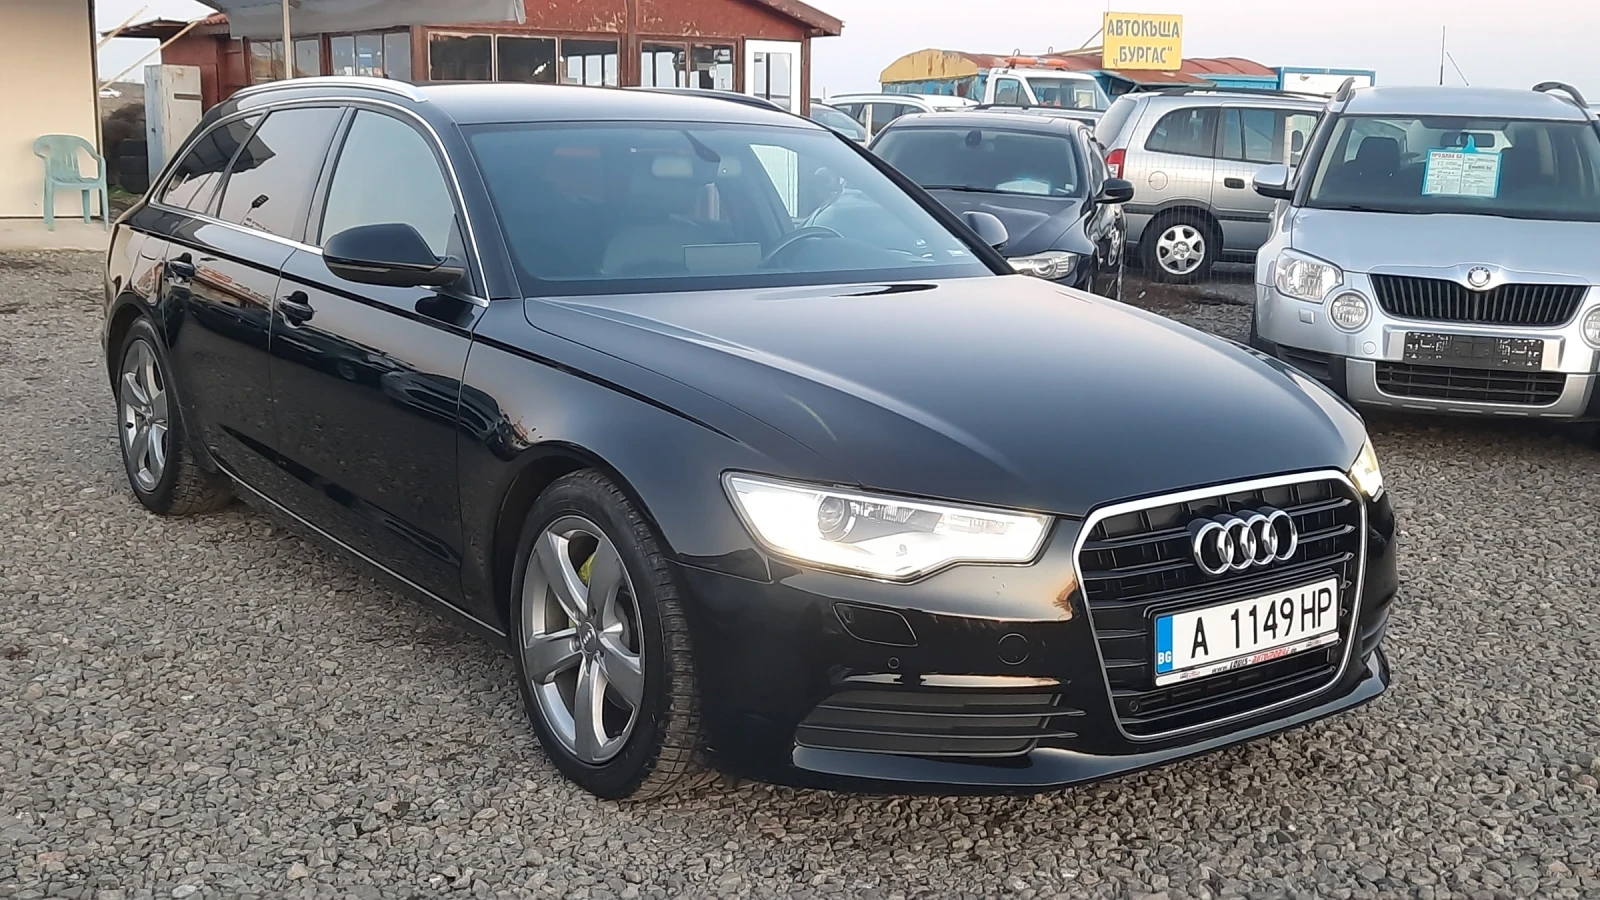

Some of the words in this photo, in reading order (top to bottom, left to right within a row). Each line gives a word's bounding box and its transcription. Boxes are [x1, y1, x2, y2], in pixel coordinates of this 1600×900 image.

[1191, 617, 1209, 659] A
[1231, 597, 1294, 648] 1149
[1301, 587, 1332, 632] HP
[1158, 652, 1172, 664] BG
